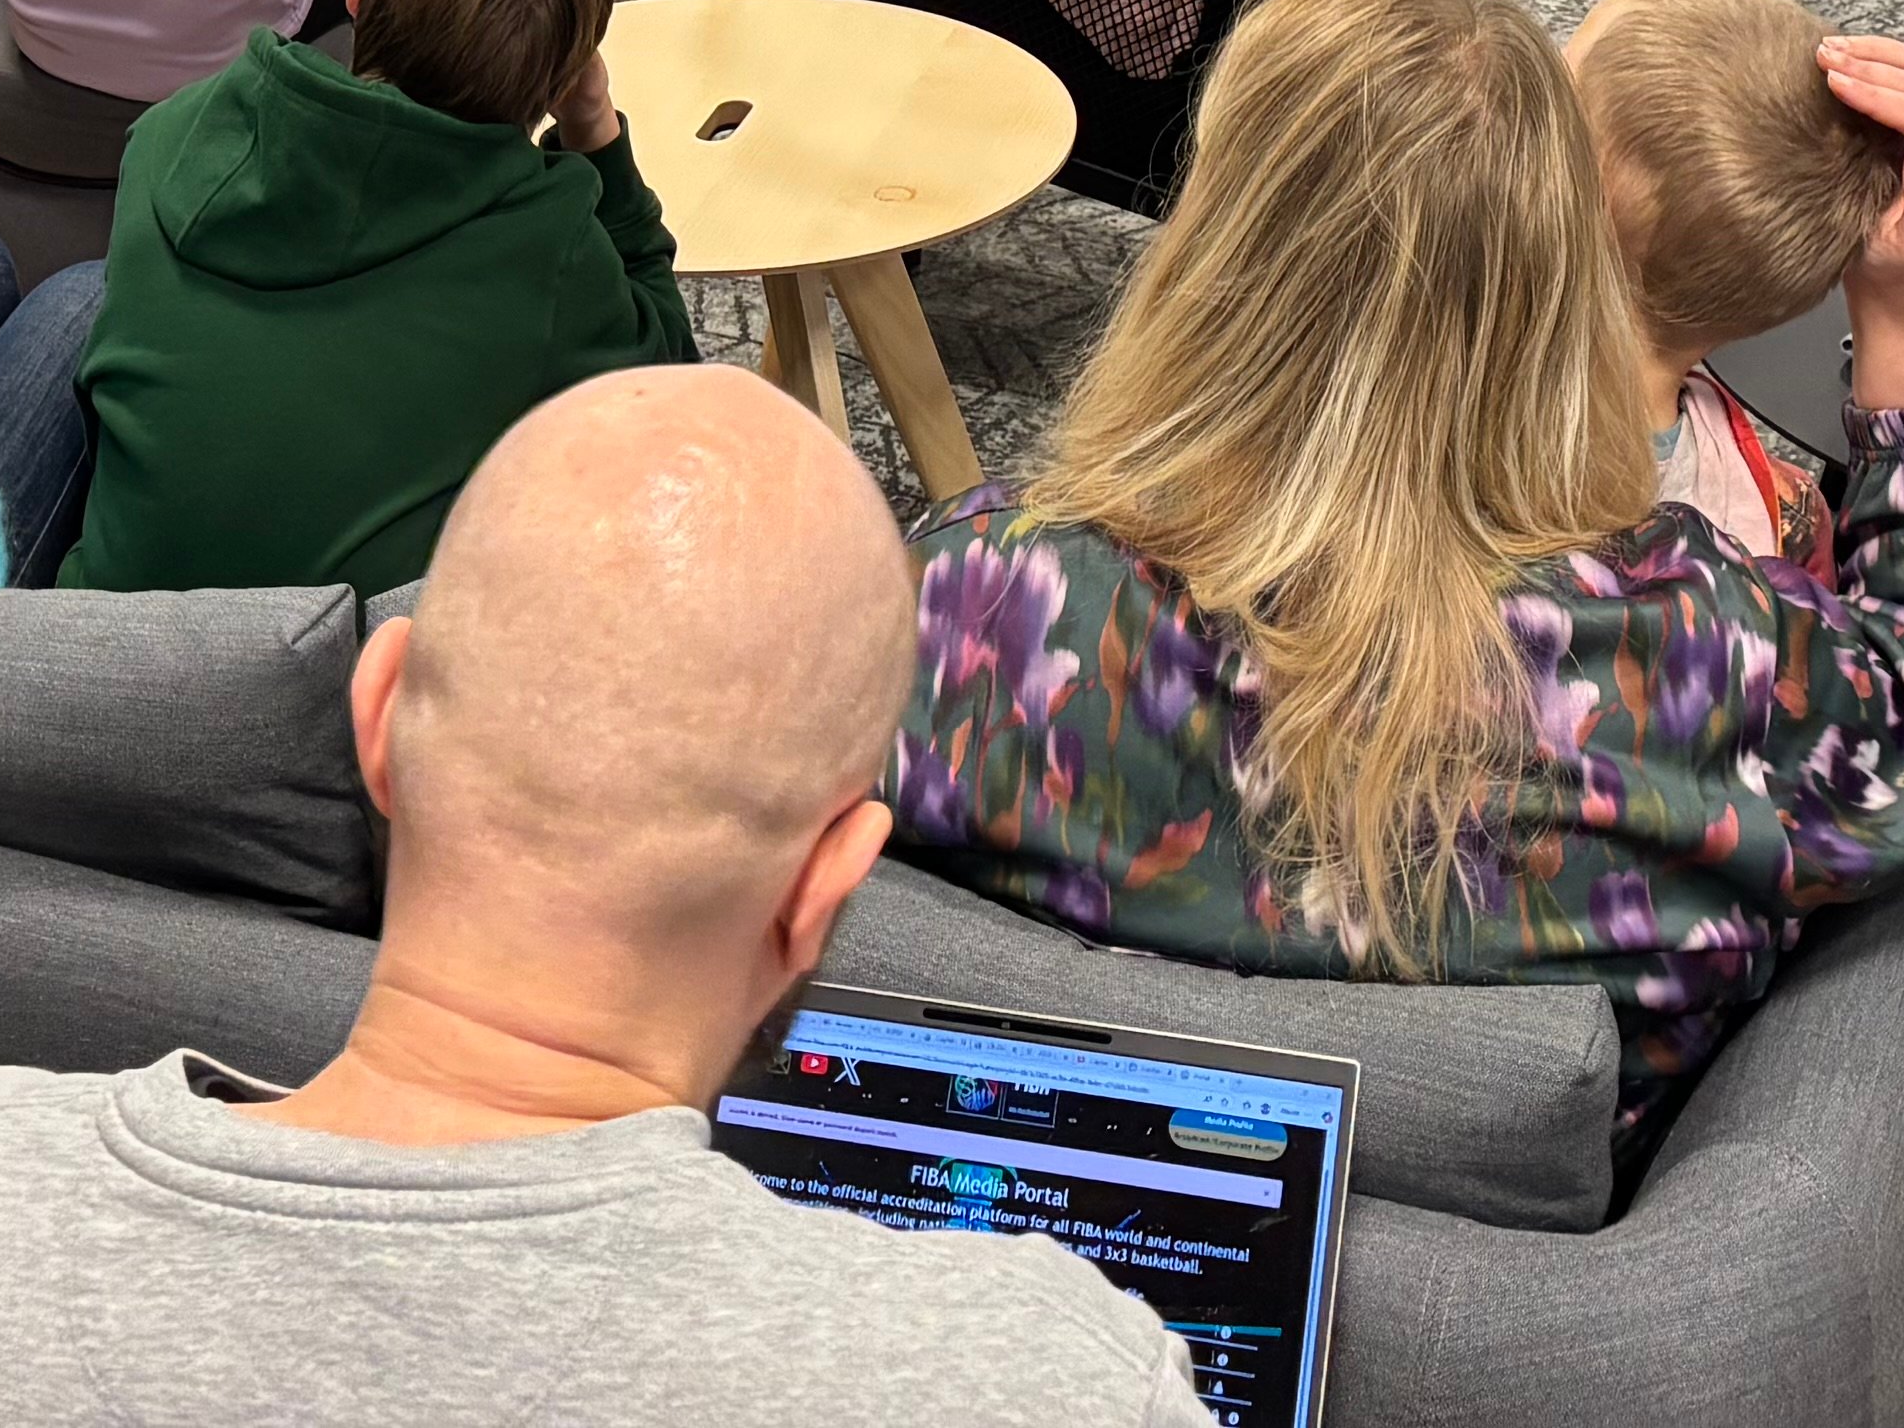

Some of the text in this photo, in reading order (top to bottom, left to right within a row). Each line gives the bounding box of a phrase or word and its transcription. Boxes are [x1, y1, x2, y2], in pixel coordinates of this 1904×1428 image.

[911, 1165, 1069, 1208] FIBA Media Portal
[790, 1178, 805, 1192] to
[807, 1179, 830, 1196] the
[831, 1184, 878, 1203] official
[880, 1193, 967, 1217] accreditation
[969, 1204, 1026, 1227] platform
[1030, 1214, 1050, 1229] for
[1052, 1219, 1070, 1234] all
[1072, 1221, 1102, 1240] FIBA
[1104, 1228, 1143, 1245] world
[1146, 1235, 1171, 1250] and
[1174, 1239, 1250, 1263] continental
[1076, 1244, 1102, 1259] and
[1104, 1246, 1128, 1262] 3x3
[1130, 1249, 1203, 1275] basketball.
